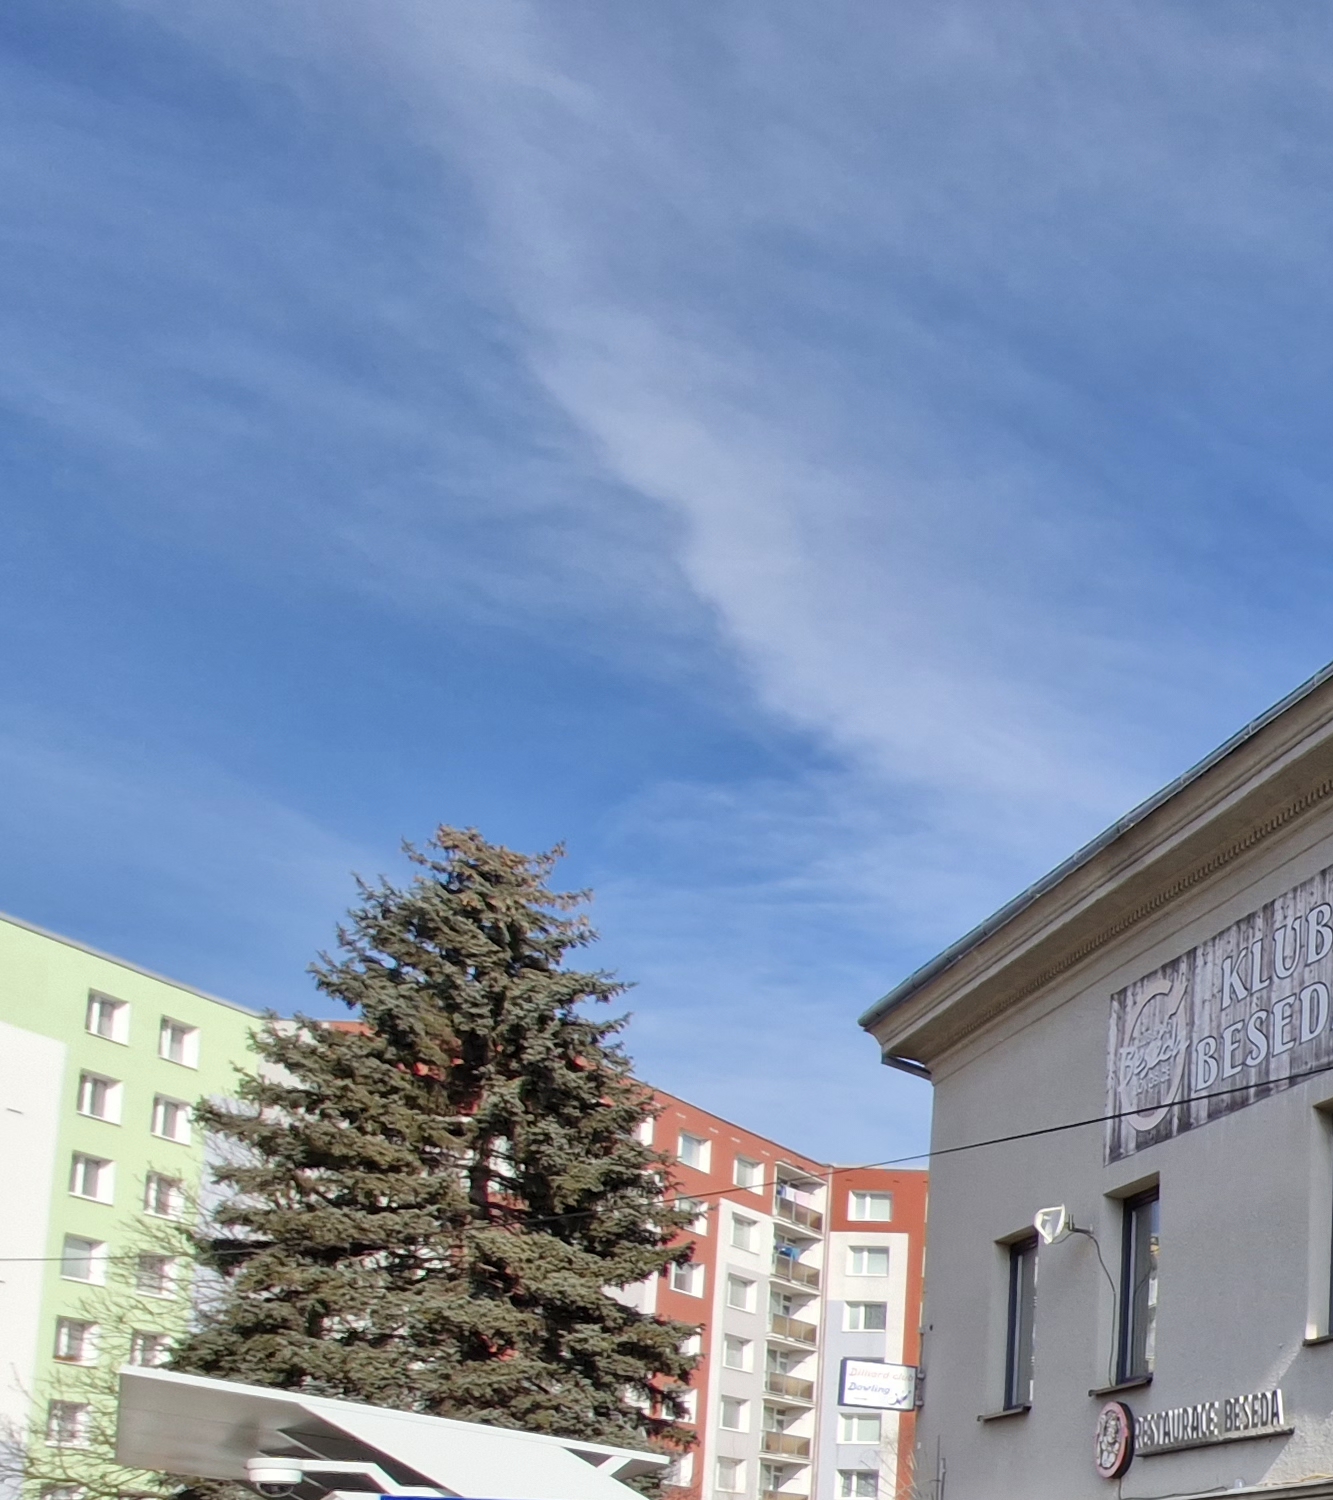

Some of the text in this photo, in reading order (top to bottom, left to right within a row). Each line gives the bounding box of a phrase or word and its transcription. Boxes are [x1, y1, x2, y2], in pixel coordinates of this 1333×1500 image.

[1220, 901, 1333, 1010] KLUB
[1134, 1388, 1284, 1449] RESTAURACE BESEDA
